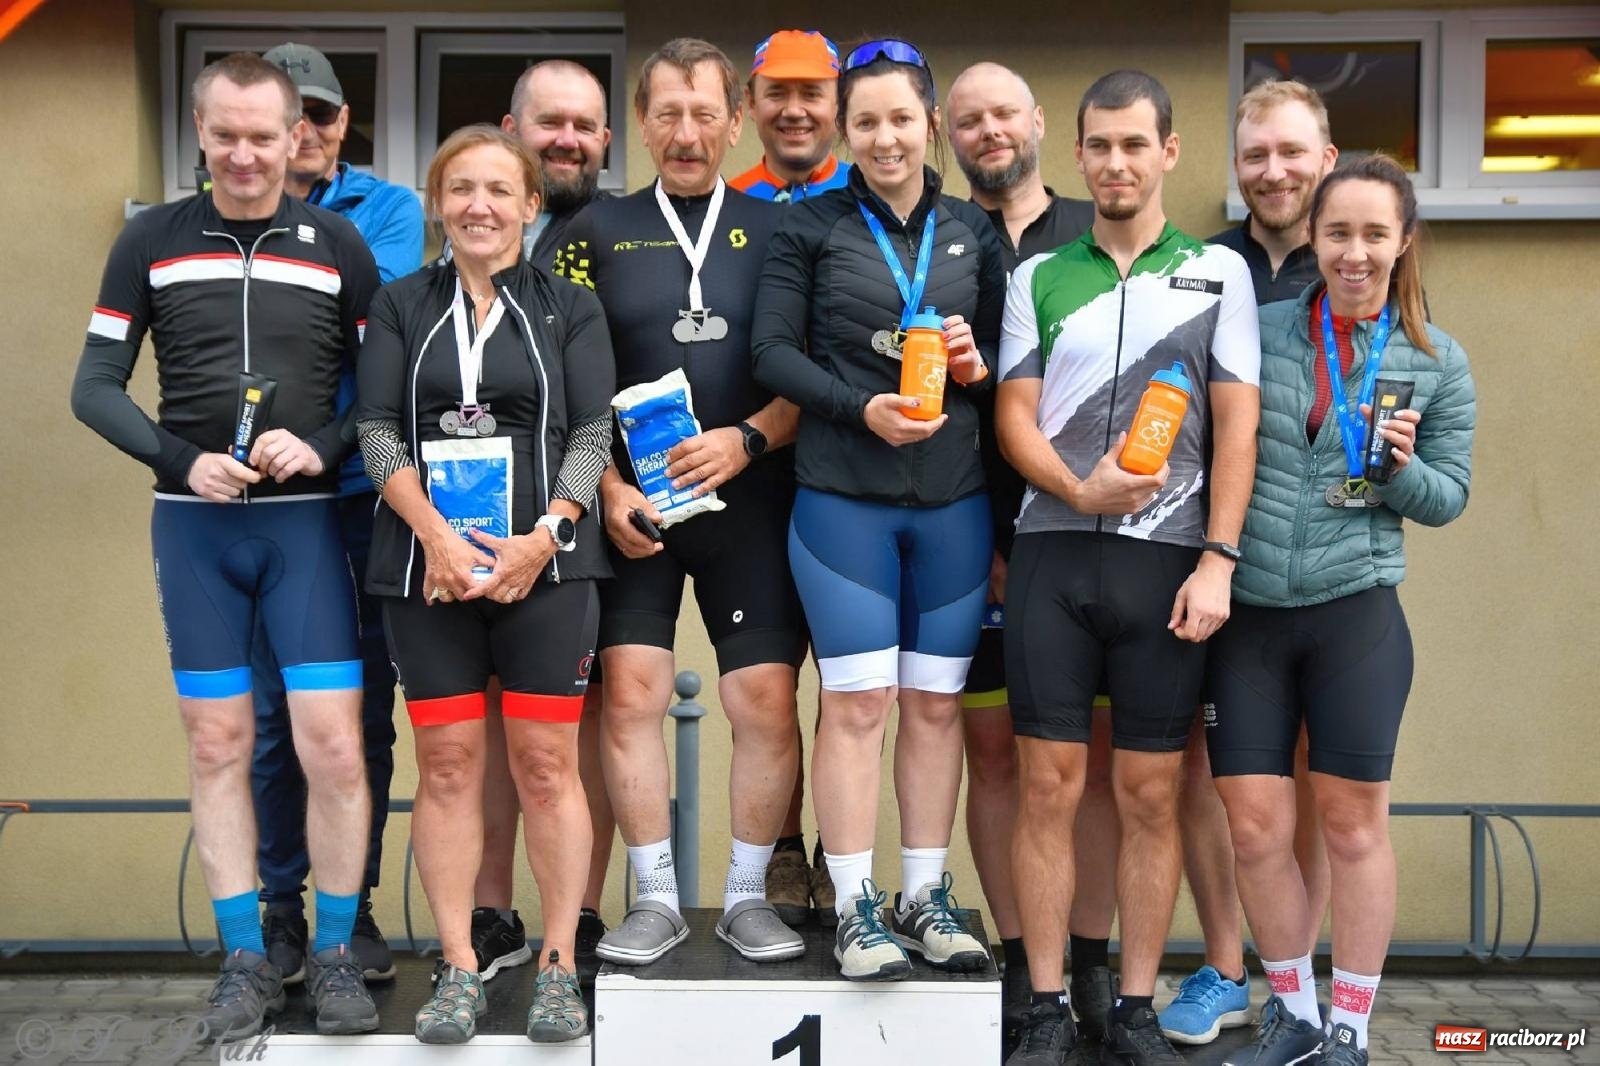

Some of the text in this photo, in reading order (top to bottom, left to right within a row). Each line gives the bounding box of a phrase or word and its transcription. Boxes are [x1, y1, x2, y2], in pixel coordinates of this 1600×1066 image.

[638, 458, 668, 477] THERA
[462, 516, 494, 528] SPORT
[772, 1014, 821, 1066] 1
